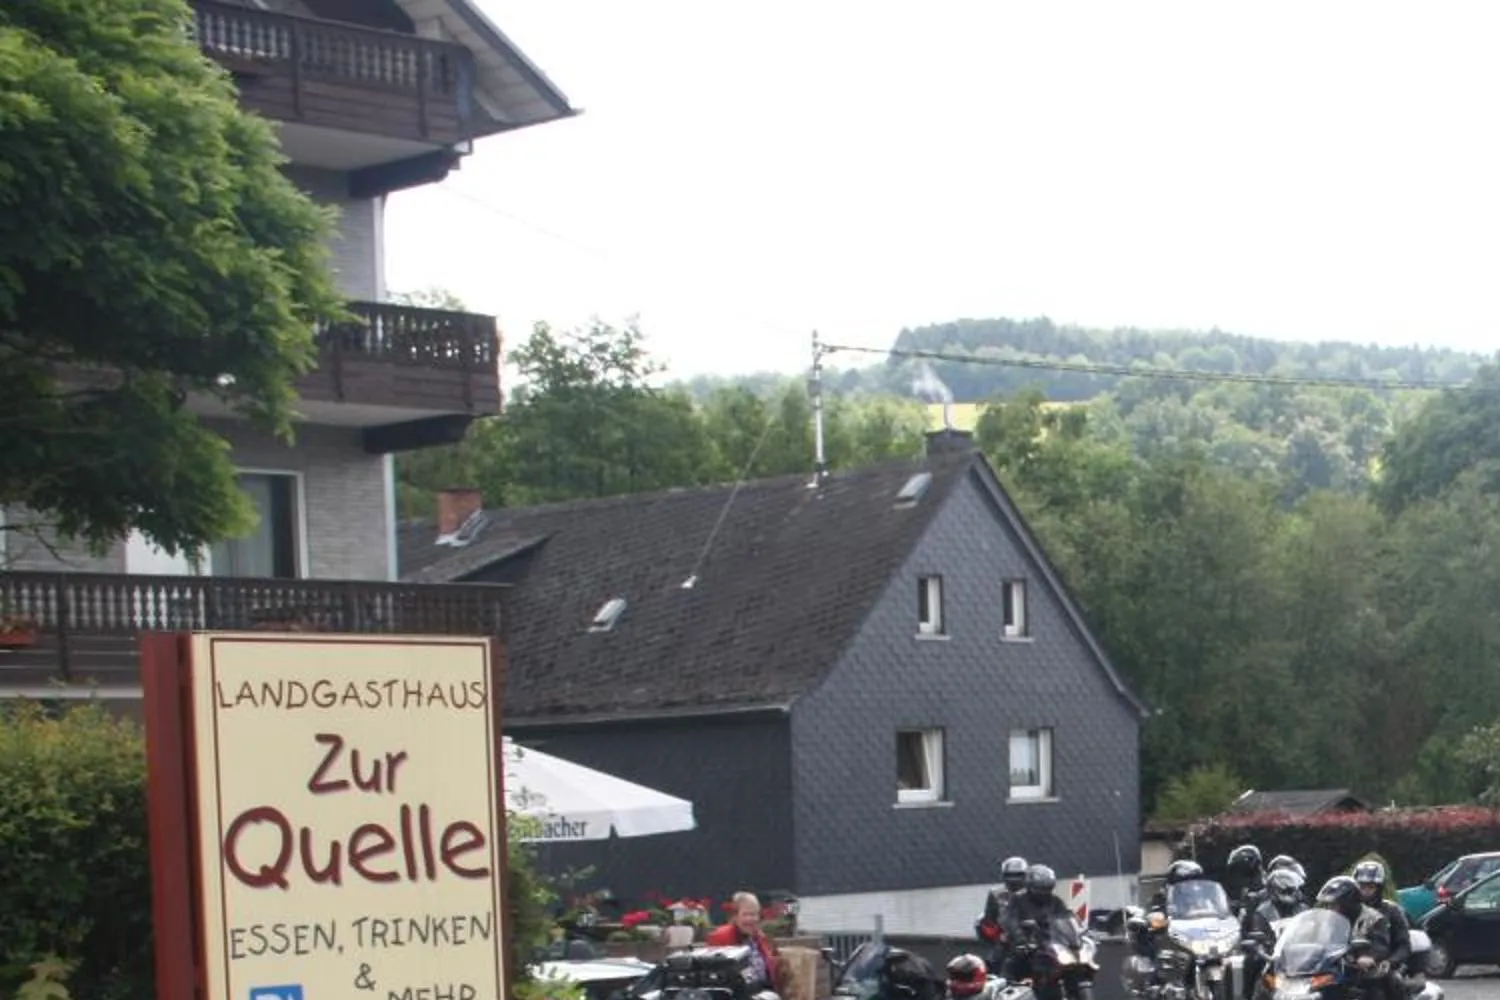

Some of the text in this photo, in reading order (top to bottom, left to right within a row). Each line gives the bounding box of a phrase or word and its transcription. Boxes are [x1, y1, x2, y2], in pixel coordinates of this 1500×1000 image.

[216, 679, 486, 710] LANDGASTHAUS
[307, 733, 408, 795] Zur
[223, 803, 491, 891] Quelle
[229, 911, 492, 960] ESSEN, TRINKEN
[353, 962, 377, 992] &
